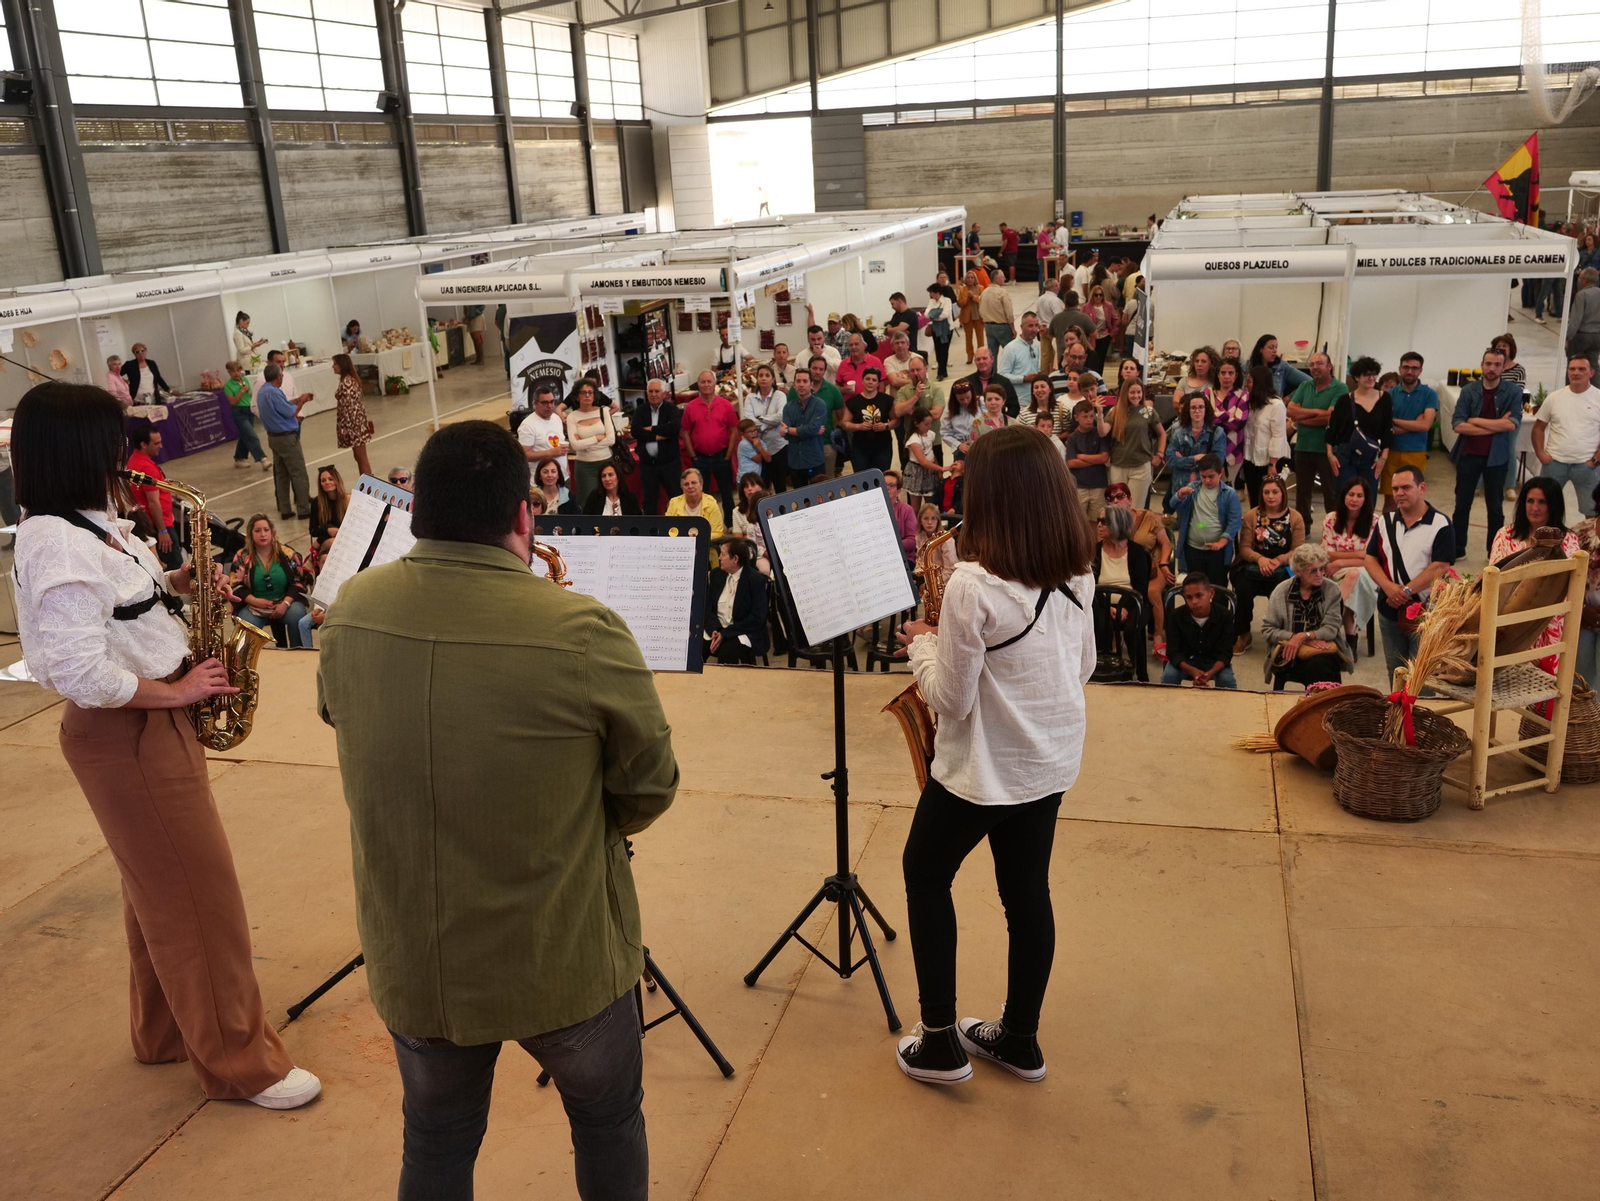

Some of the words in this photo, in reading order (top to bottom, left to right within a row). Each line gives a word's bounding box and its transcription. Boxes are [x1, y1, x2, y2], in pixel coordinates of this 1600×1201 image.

[1205, 262, 1240, 270] QUESOS
[1243, 260, 1289, 270] PLAZUELO
[1357, 258, 1378, 268] MIEL
[1381, 258, 1387, 266] Y
[1389, 257, 1426, 267] DULCES
[1429, 256, 1506, 266] TRADICIONALES
[1508, 255, 1522, 264] DE
[1524, 254, 1565, 264] CARMEN
[440, 286, 454, 294] UAS
[456, 284, 492, 294] INGENIERIA
[494, 283, 528, 292] APLICADA
[528, 282, 542, 290] S.L.
[590, 278, 624, 288] JAMONES
[626, 278, 632, 287] Y
[632, 278, 672, 288] EMBUTIDOS
[674, 276, 706, 286] NEMESIO
[20, 307, 32, 316] HIJA
[530, 368, 562, 380] NEMESIO
